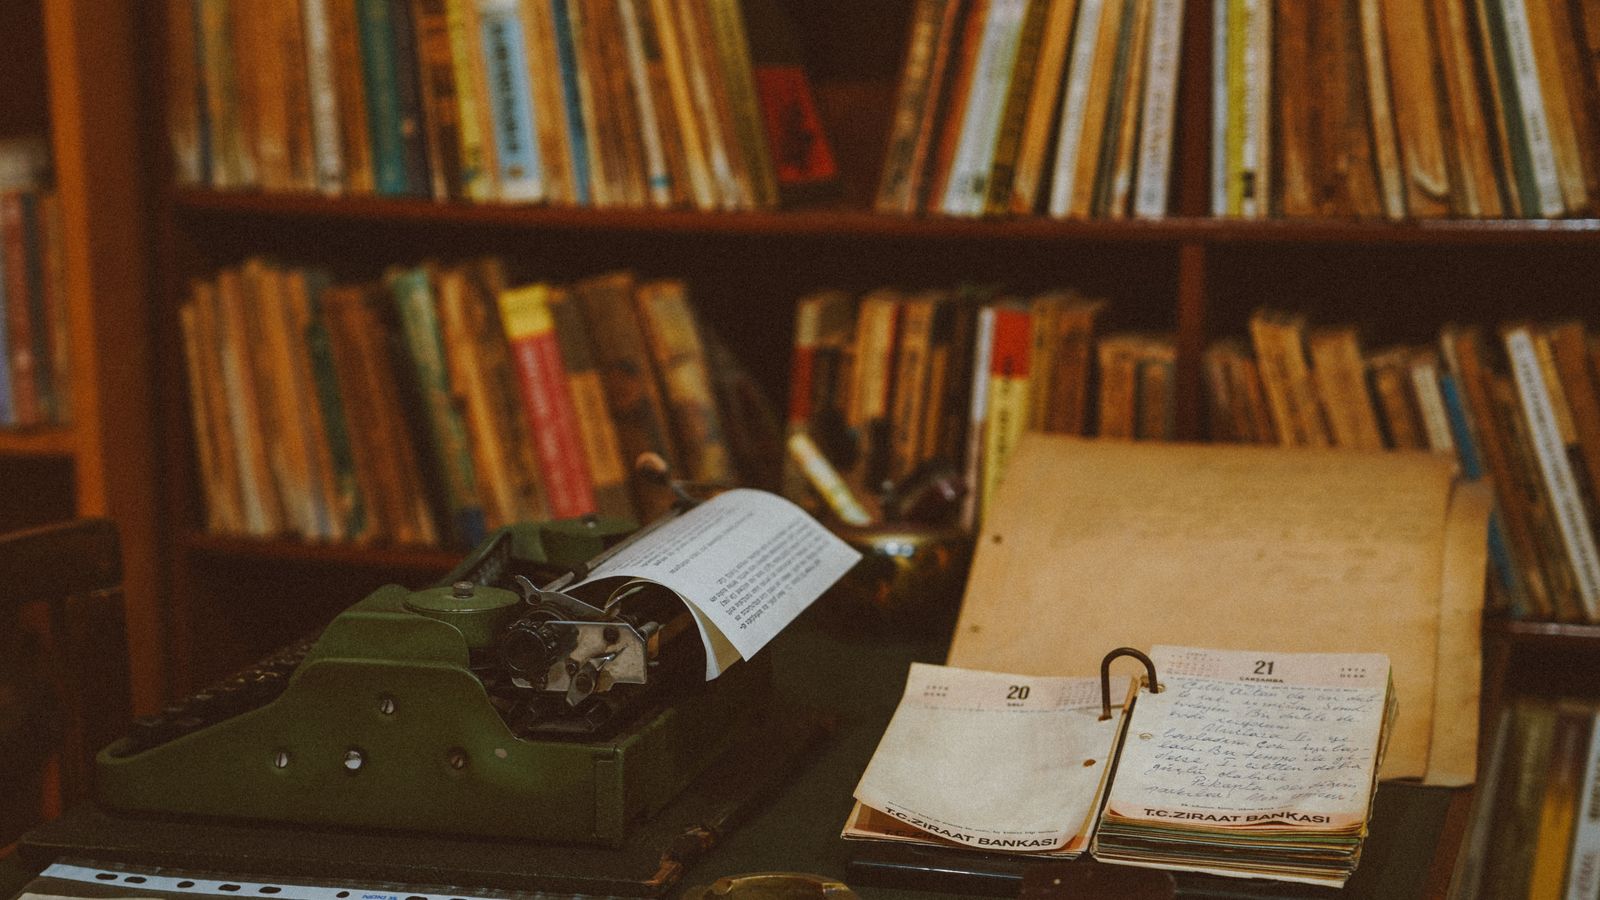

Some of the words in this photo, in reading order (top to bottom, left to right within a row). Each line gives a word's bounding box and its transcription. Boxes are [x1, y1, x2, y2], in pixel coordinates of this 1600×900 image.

[1253, 660, 1274, 675] 21
[1006, 685, 1031, 700] 20
[1246, 812, 1331, 824] BANKASI
[978, 837, 1058, 848] BANKASI
